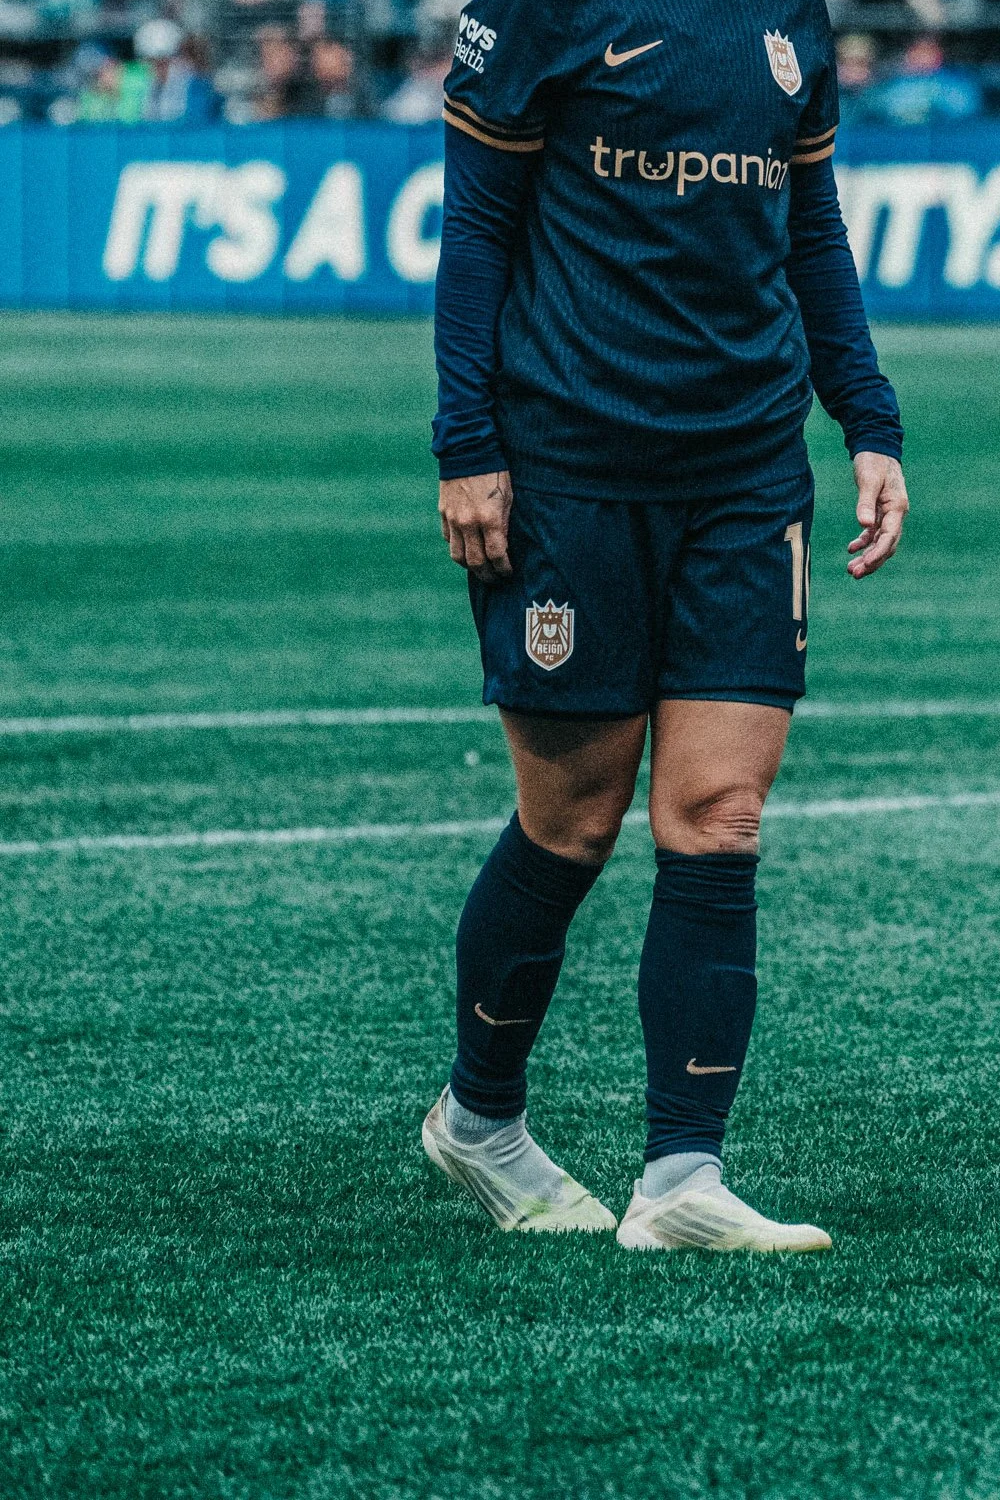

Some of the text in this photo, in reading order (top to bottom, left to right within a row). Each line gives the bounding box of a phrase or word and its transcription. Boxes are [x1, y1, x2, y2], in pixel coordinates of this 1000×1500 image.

[466, 17, 497, 51] CVS
[102, 161, 285, 282] IT'S
[283, 161, 366, 282] A
[784, 521, 810, 621] 1
[537, 643, 563, 656] REIGN
